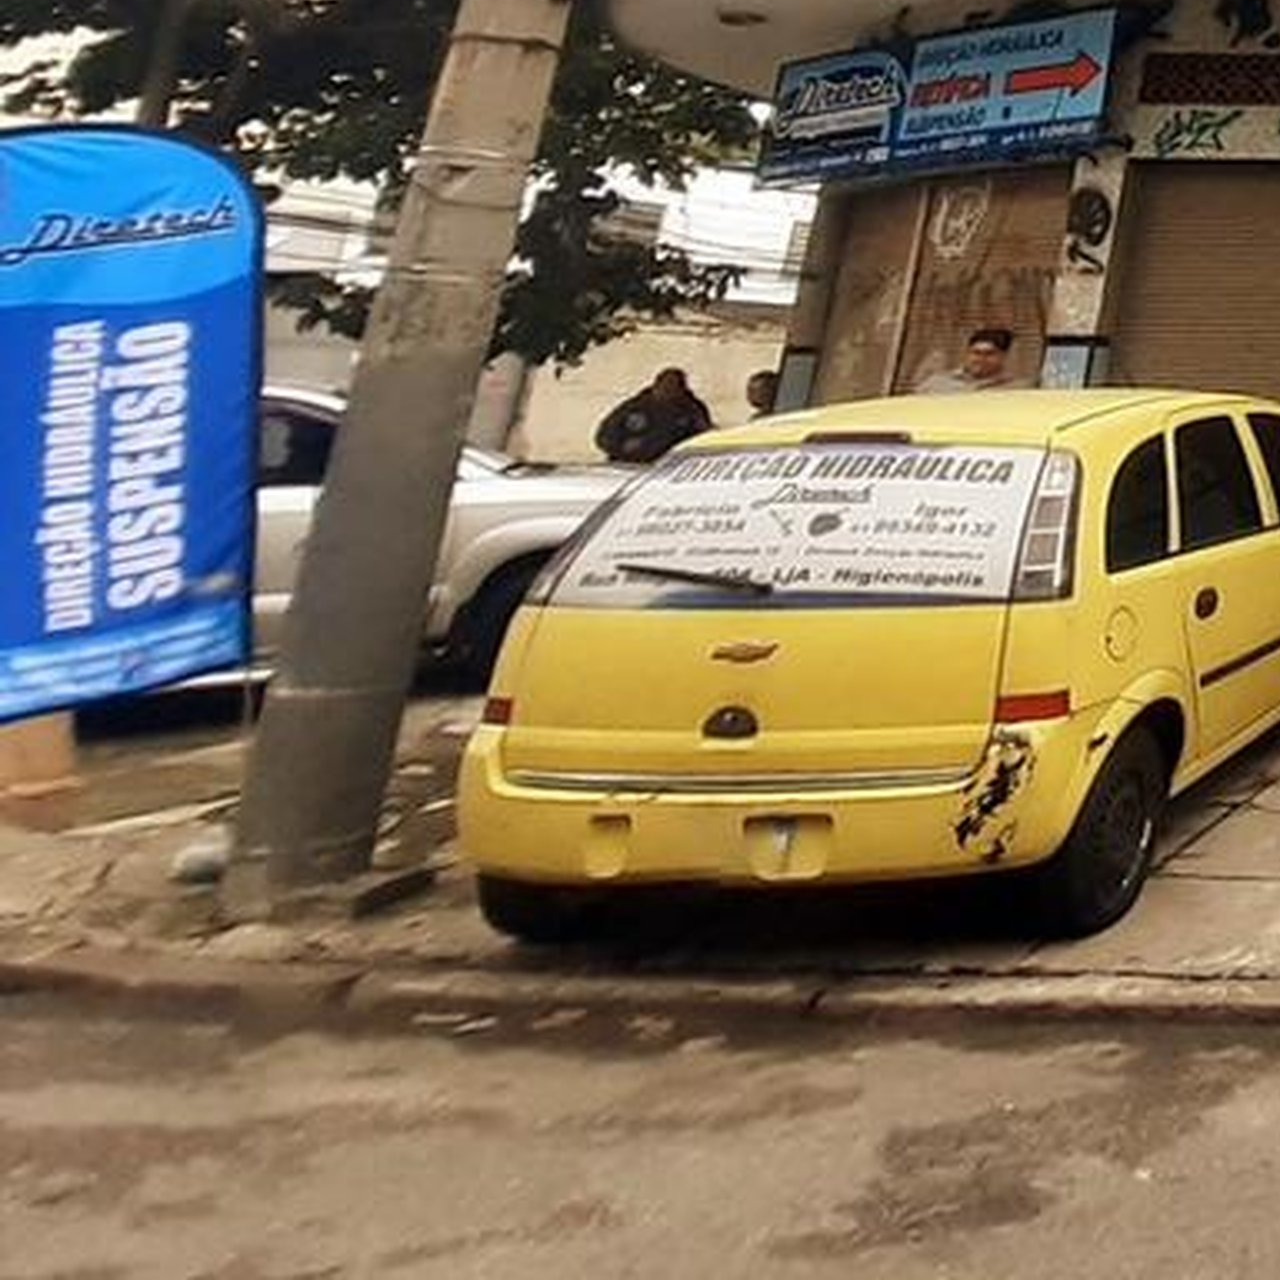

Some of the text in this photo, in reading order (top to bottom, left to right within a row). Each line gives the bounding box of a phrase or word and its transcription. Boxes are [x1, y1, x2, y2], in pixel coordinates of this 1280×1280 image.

[36, 320, 106, 633] DIREÇÃO HIDRÁULICA
[102, 320, 190, 610] SUSPENSÃO
